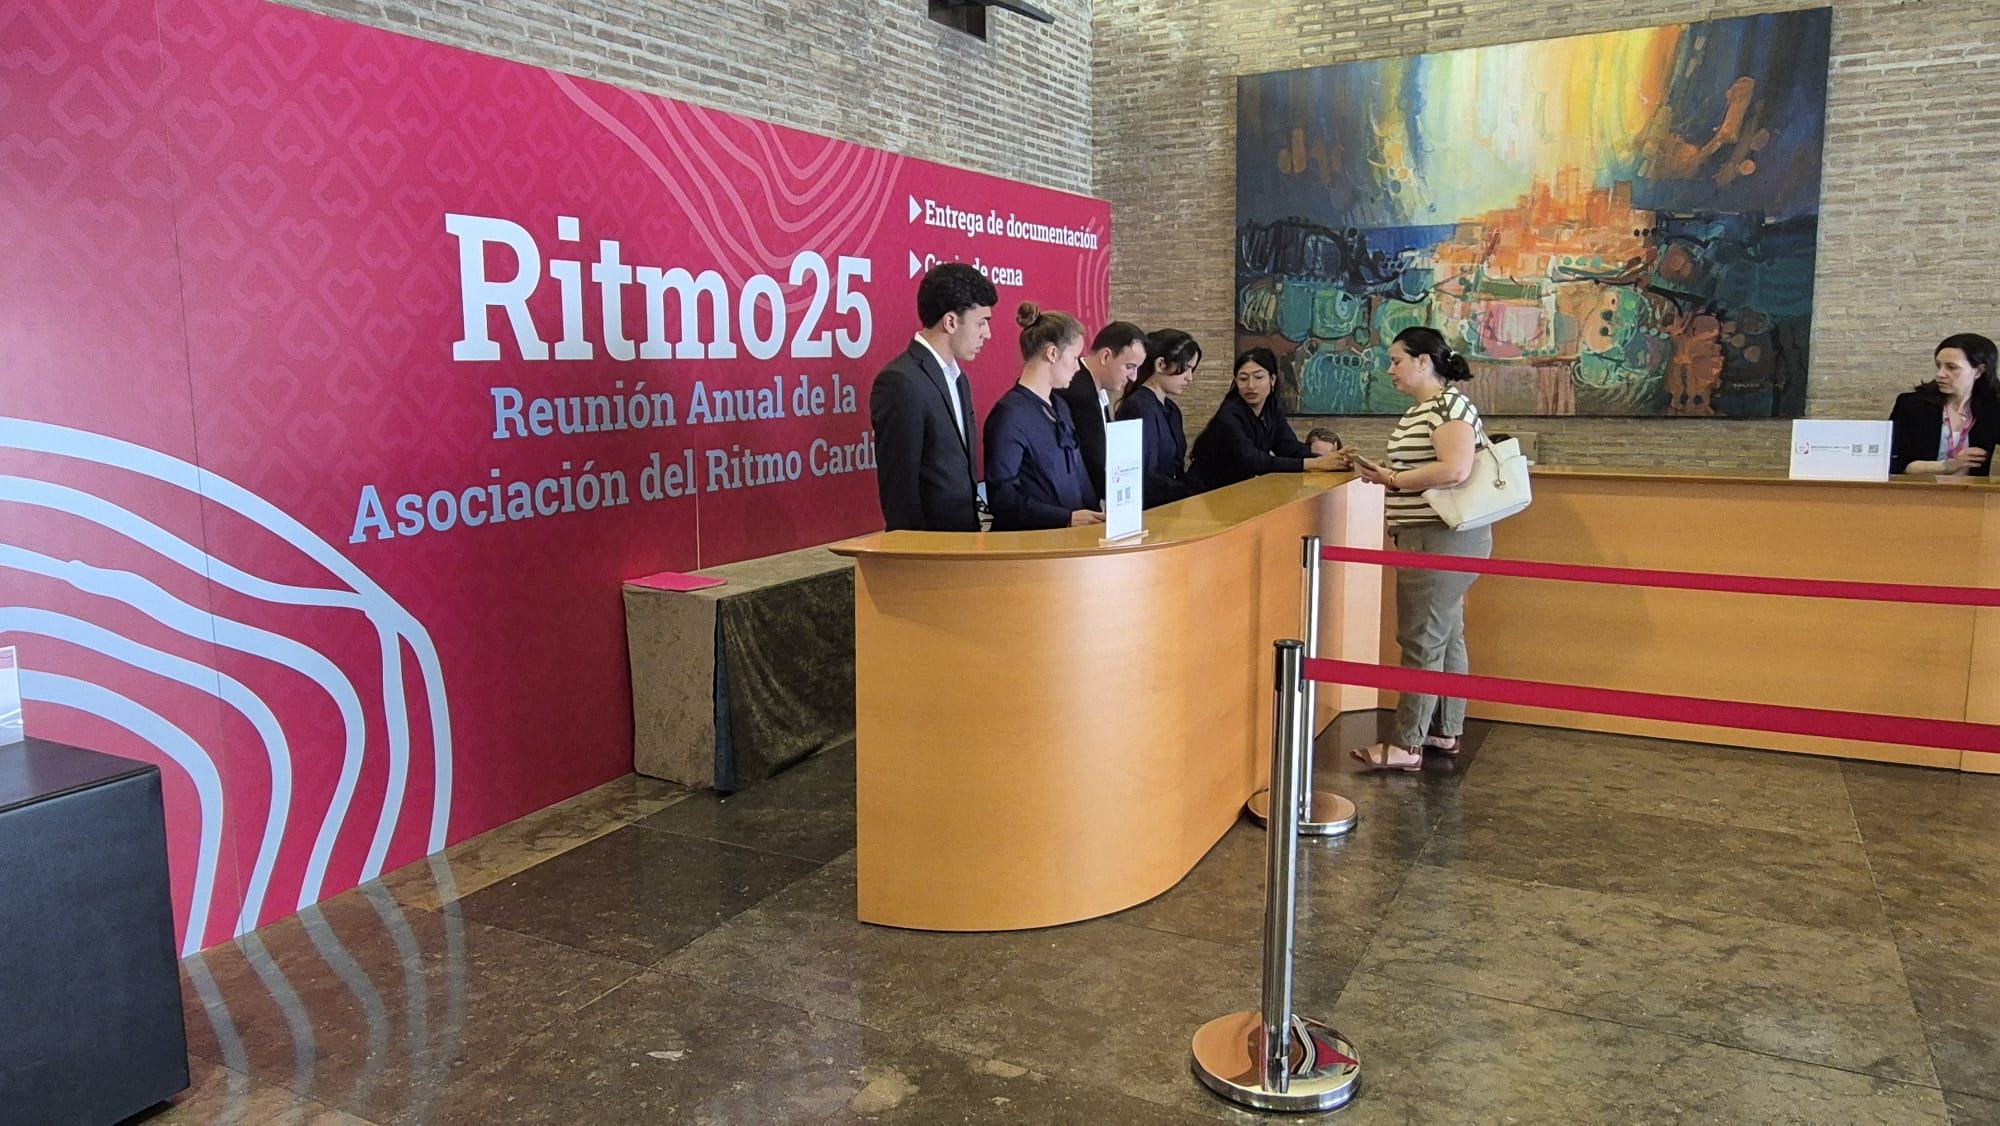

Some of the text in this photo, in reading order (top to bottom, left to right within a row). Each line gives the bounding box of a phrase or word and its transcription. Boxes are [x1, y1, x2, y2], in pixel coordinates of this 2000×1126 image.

[924, 199, 1098, 249] Entrega de documentación
[445, 213, 872, 362] Ritmo25
[991, 266, 1023, 286] cena
[490, 373, 857, 439] Reunión Anual de la
[348, 431, 877, 544] Asociación del Ritmo Cardi
